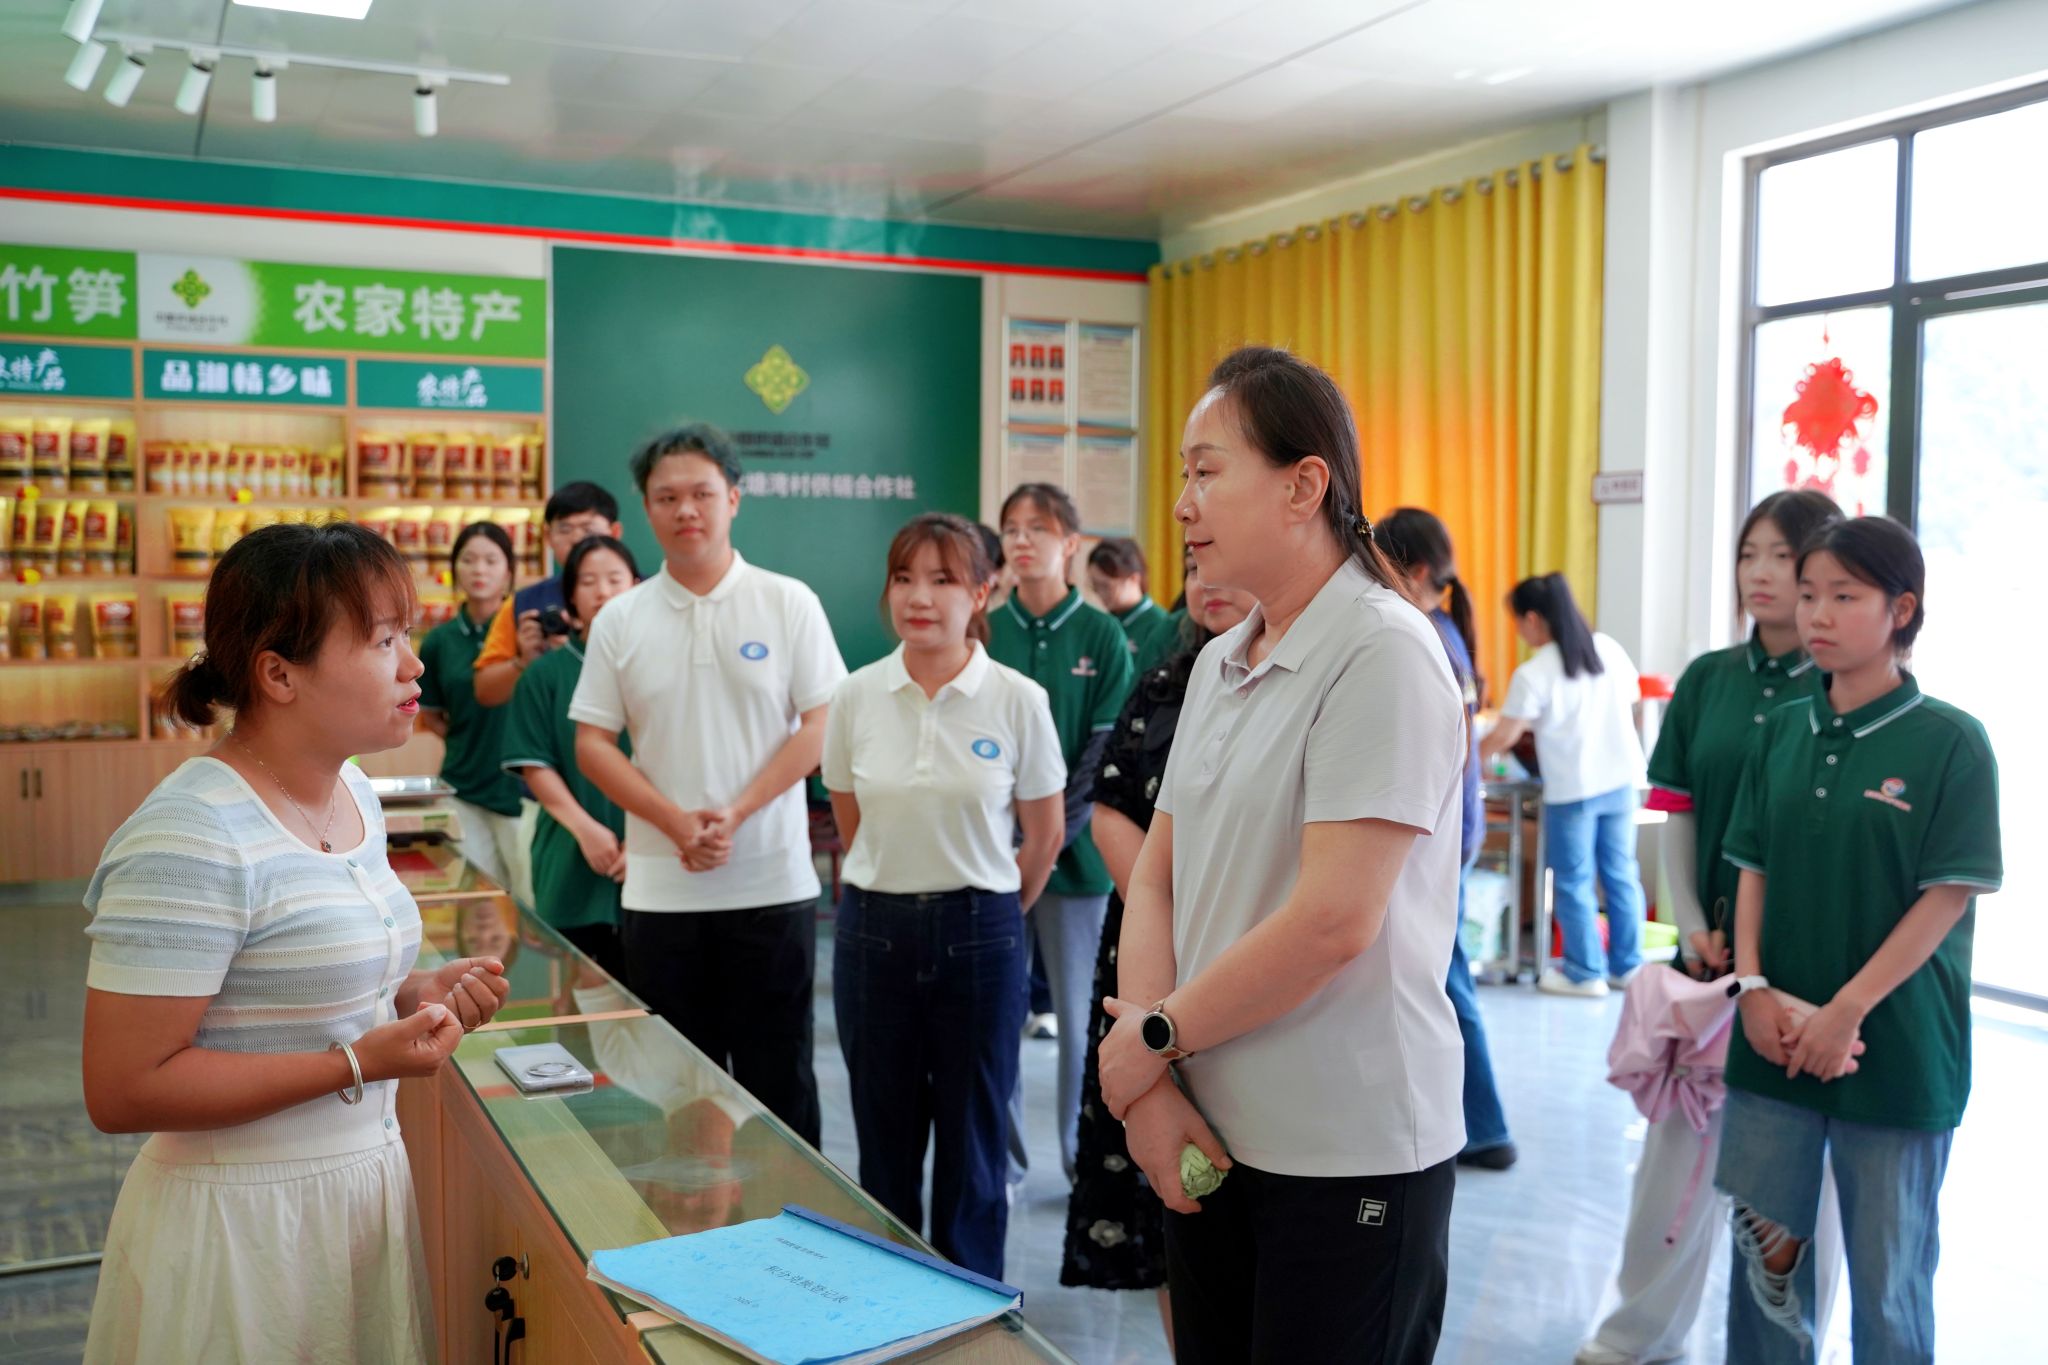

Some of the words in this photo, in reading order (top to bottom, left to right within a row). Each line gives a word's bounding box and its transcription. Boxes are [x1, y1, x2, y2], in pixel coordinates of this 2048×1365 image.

[0, 263, 127, 324] 竹笋
[293, 280, 522, 341] 农家特产
